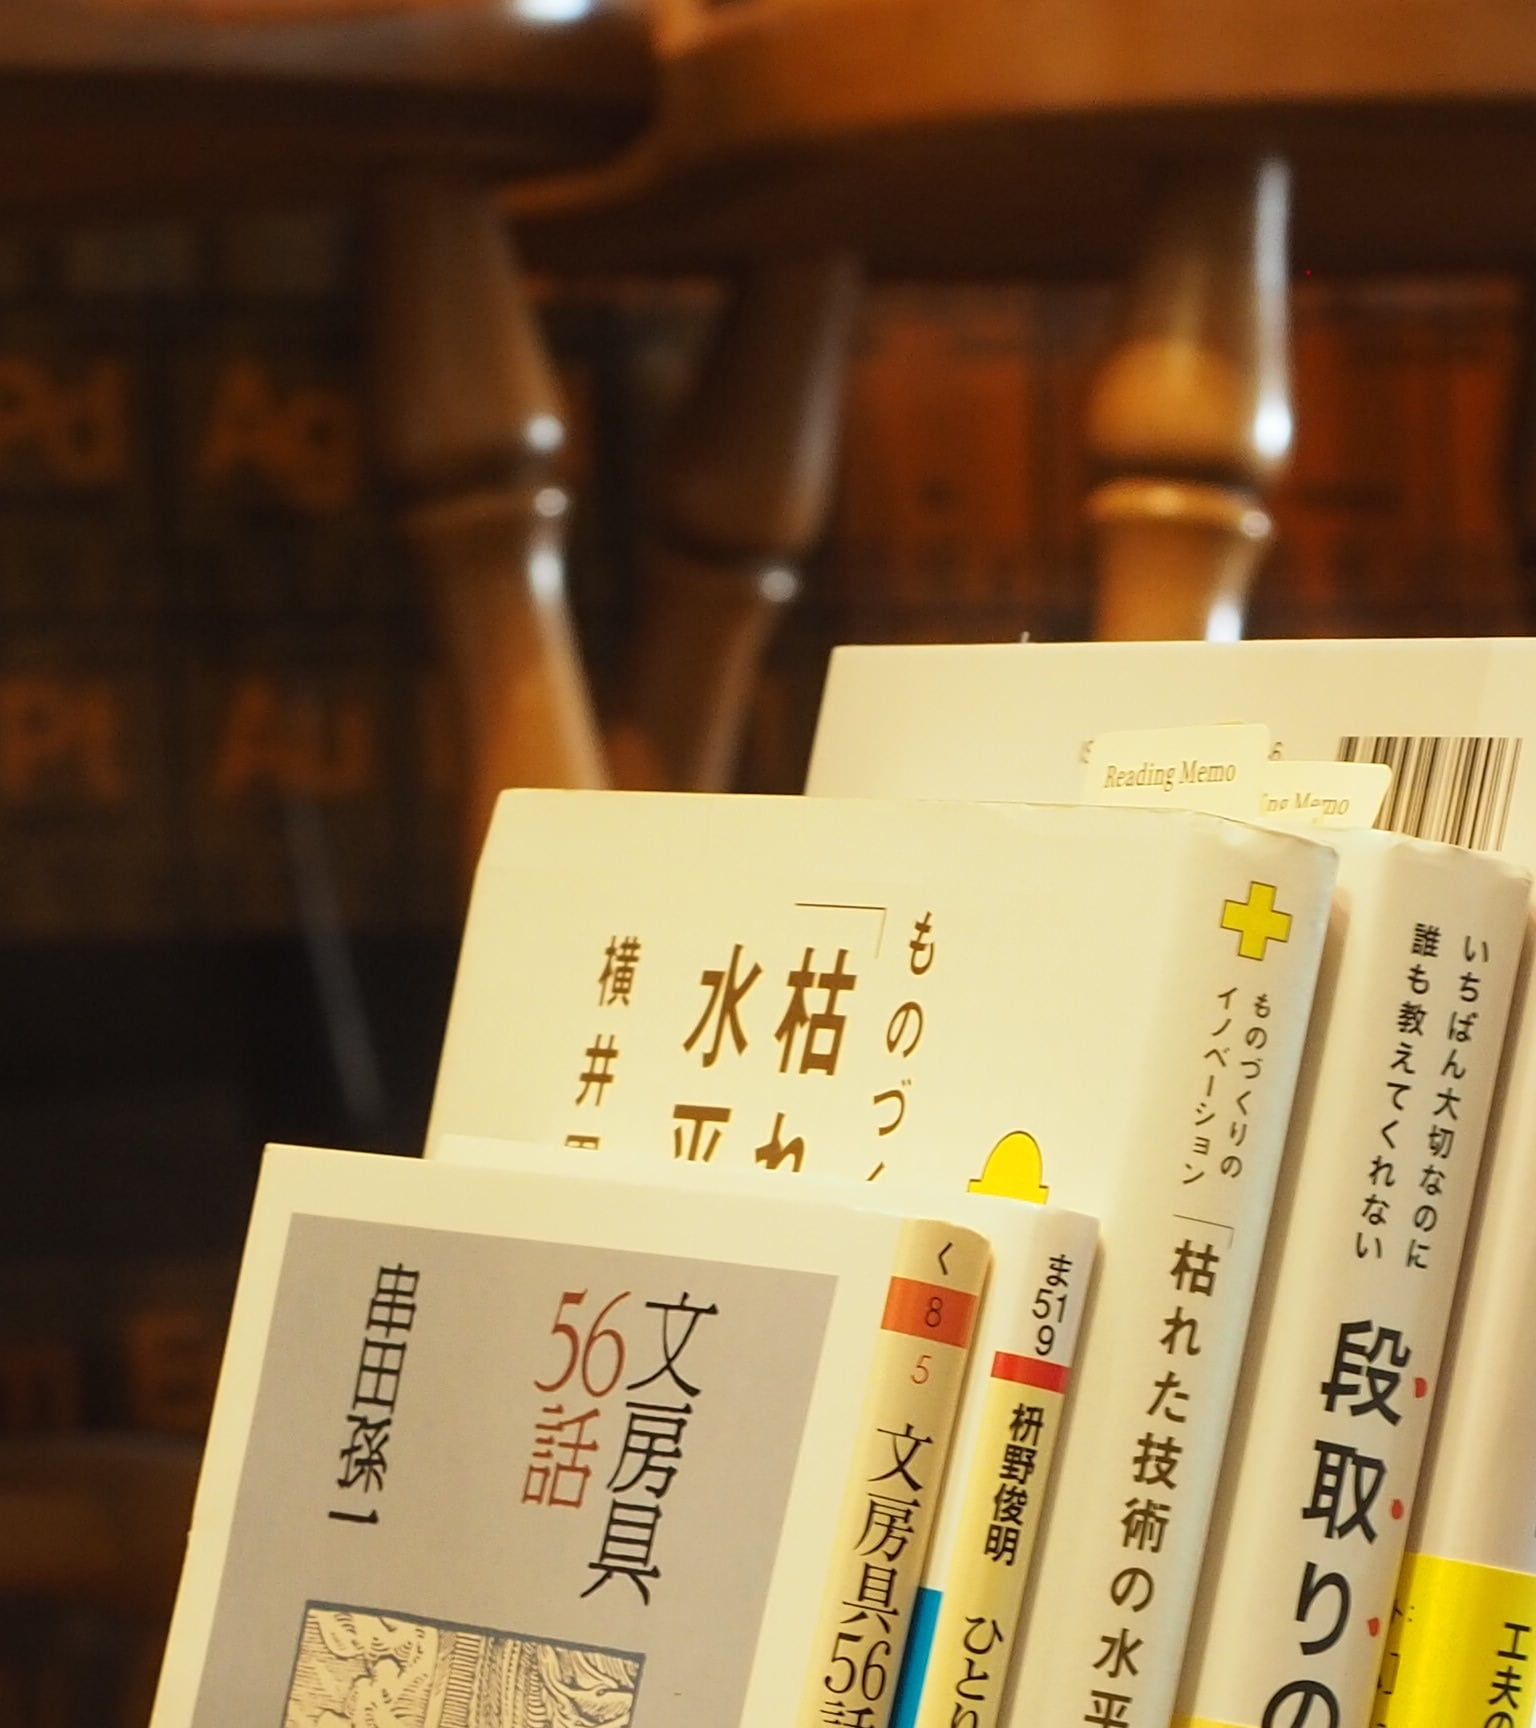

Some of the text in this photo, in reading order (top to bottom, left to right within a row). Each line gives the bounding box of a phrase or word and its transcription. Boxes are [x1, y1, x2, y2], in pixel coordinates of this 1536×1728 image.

[1104, 759, 1237, 792] Reading Memo
[564, 934, 642, 1151] 横井
[1181, 985, 1240, 1187] イノベーション
[1221, 992, 1271, 1180] ものづくりの
[1354, 921, 1443, 1263] 誰も教えてくれない
[1405, 934, 1491, 1271] いちばん大切なのに
[328, 1261, 421, 1527] 串田孫一
[521, 1288, 632, 1511] 56話
[909, 1241, 954, 1386] く 8 5
[579, 1290, 721, 1608] 文房具
[984, 1401, 1046, 1568] 枡野俊明
